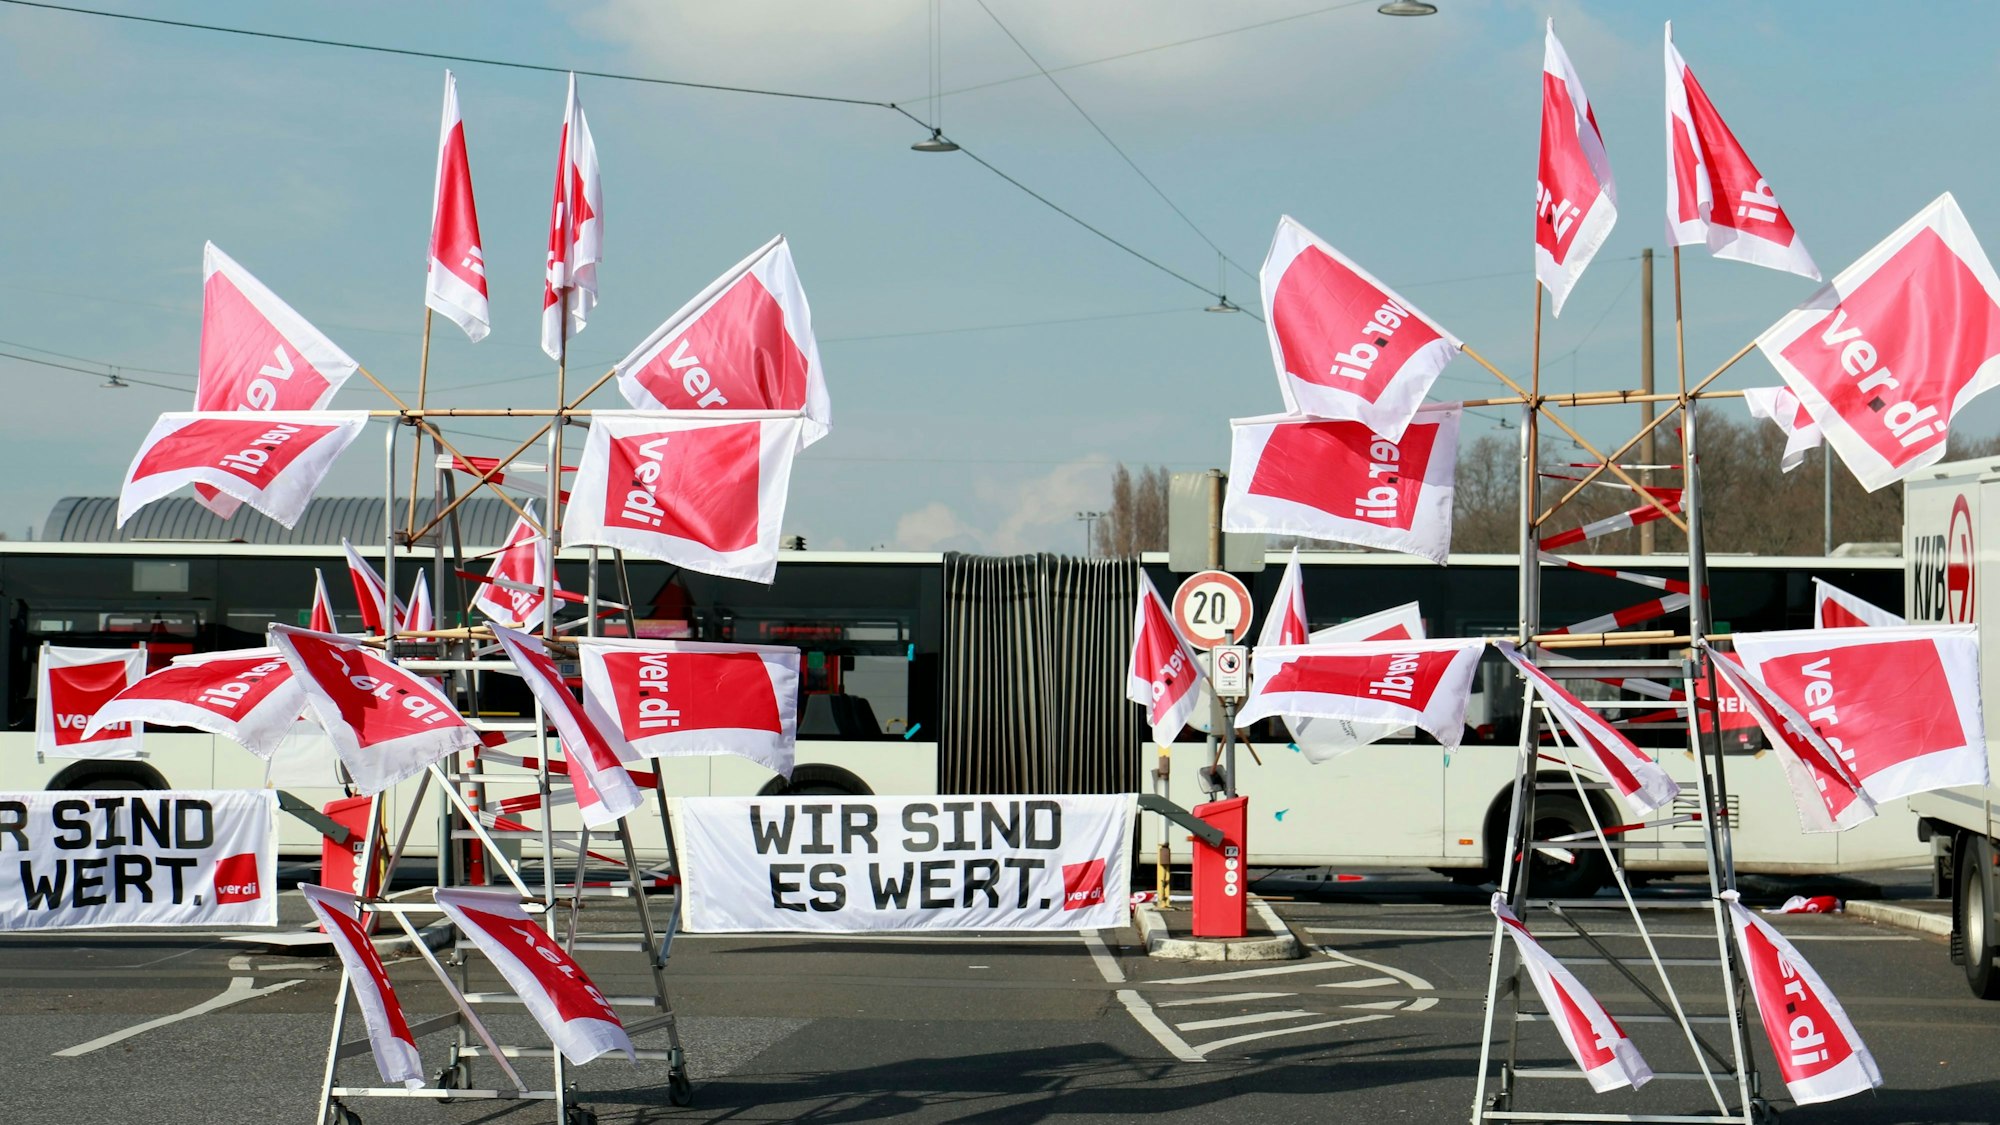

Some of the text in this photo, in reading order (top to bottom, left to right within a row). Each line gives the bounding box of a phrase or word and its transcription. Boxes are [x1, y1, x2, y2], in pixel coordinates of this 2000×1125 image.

[1820, 310, 1948, 449] ver.di
[1914, 535, 1946, 622] KVB
[1193, 590, 1226, 625] 20
[52, 797, 214, 851] SIND
[750, 800, 1062, 855] WIR SIND
[20, 853, 202, 911] WERT.
[769, 858, 1050, 912] ES WERT.
